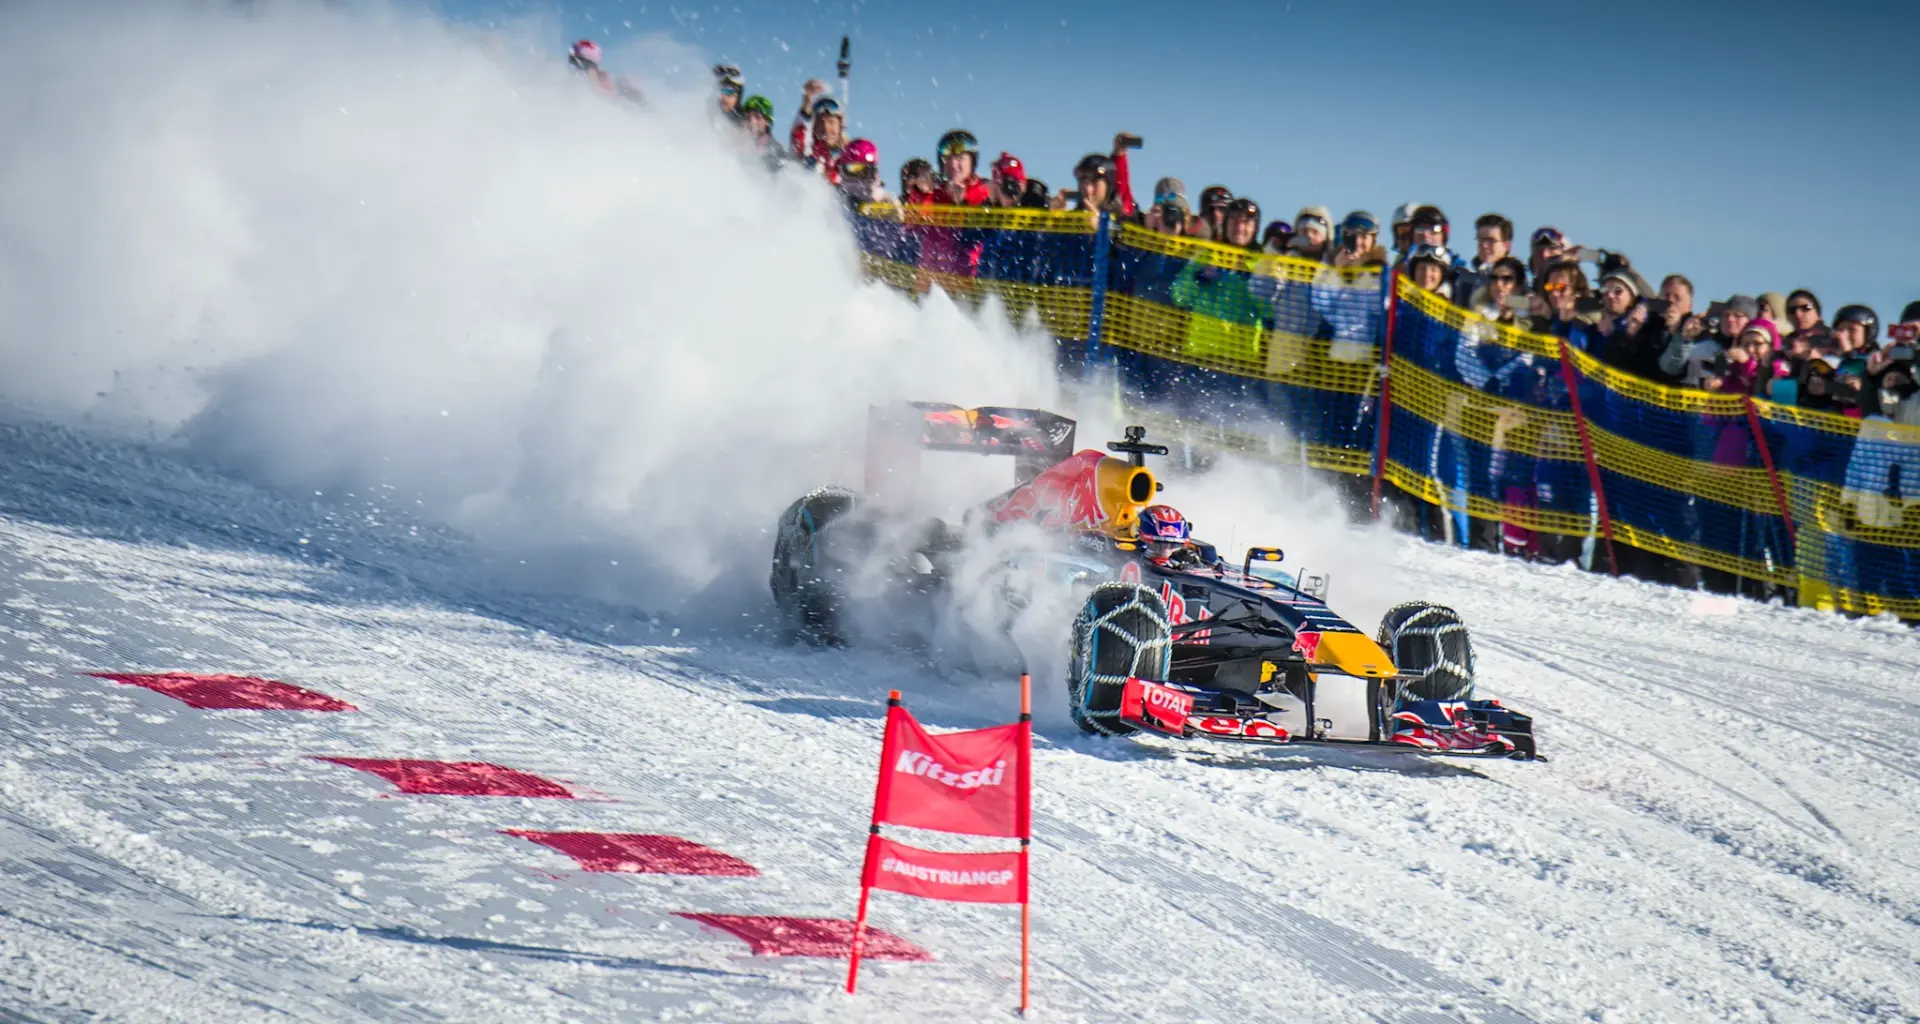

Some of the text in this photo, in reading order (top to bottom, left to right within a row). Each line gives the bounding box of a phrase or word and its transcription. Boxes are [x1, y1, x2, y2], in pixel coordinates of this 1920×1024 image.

[1138, 680, 1189, 717] TOTAL
[896, 749, 1007, 789] KitzSki
[881, 857, 1014, 885] #AUSTRIANGP
